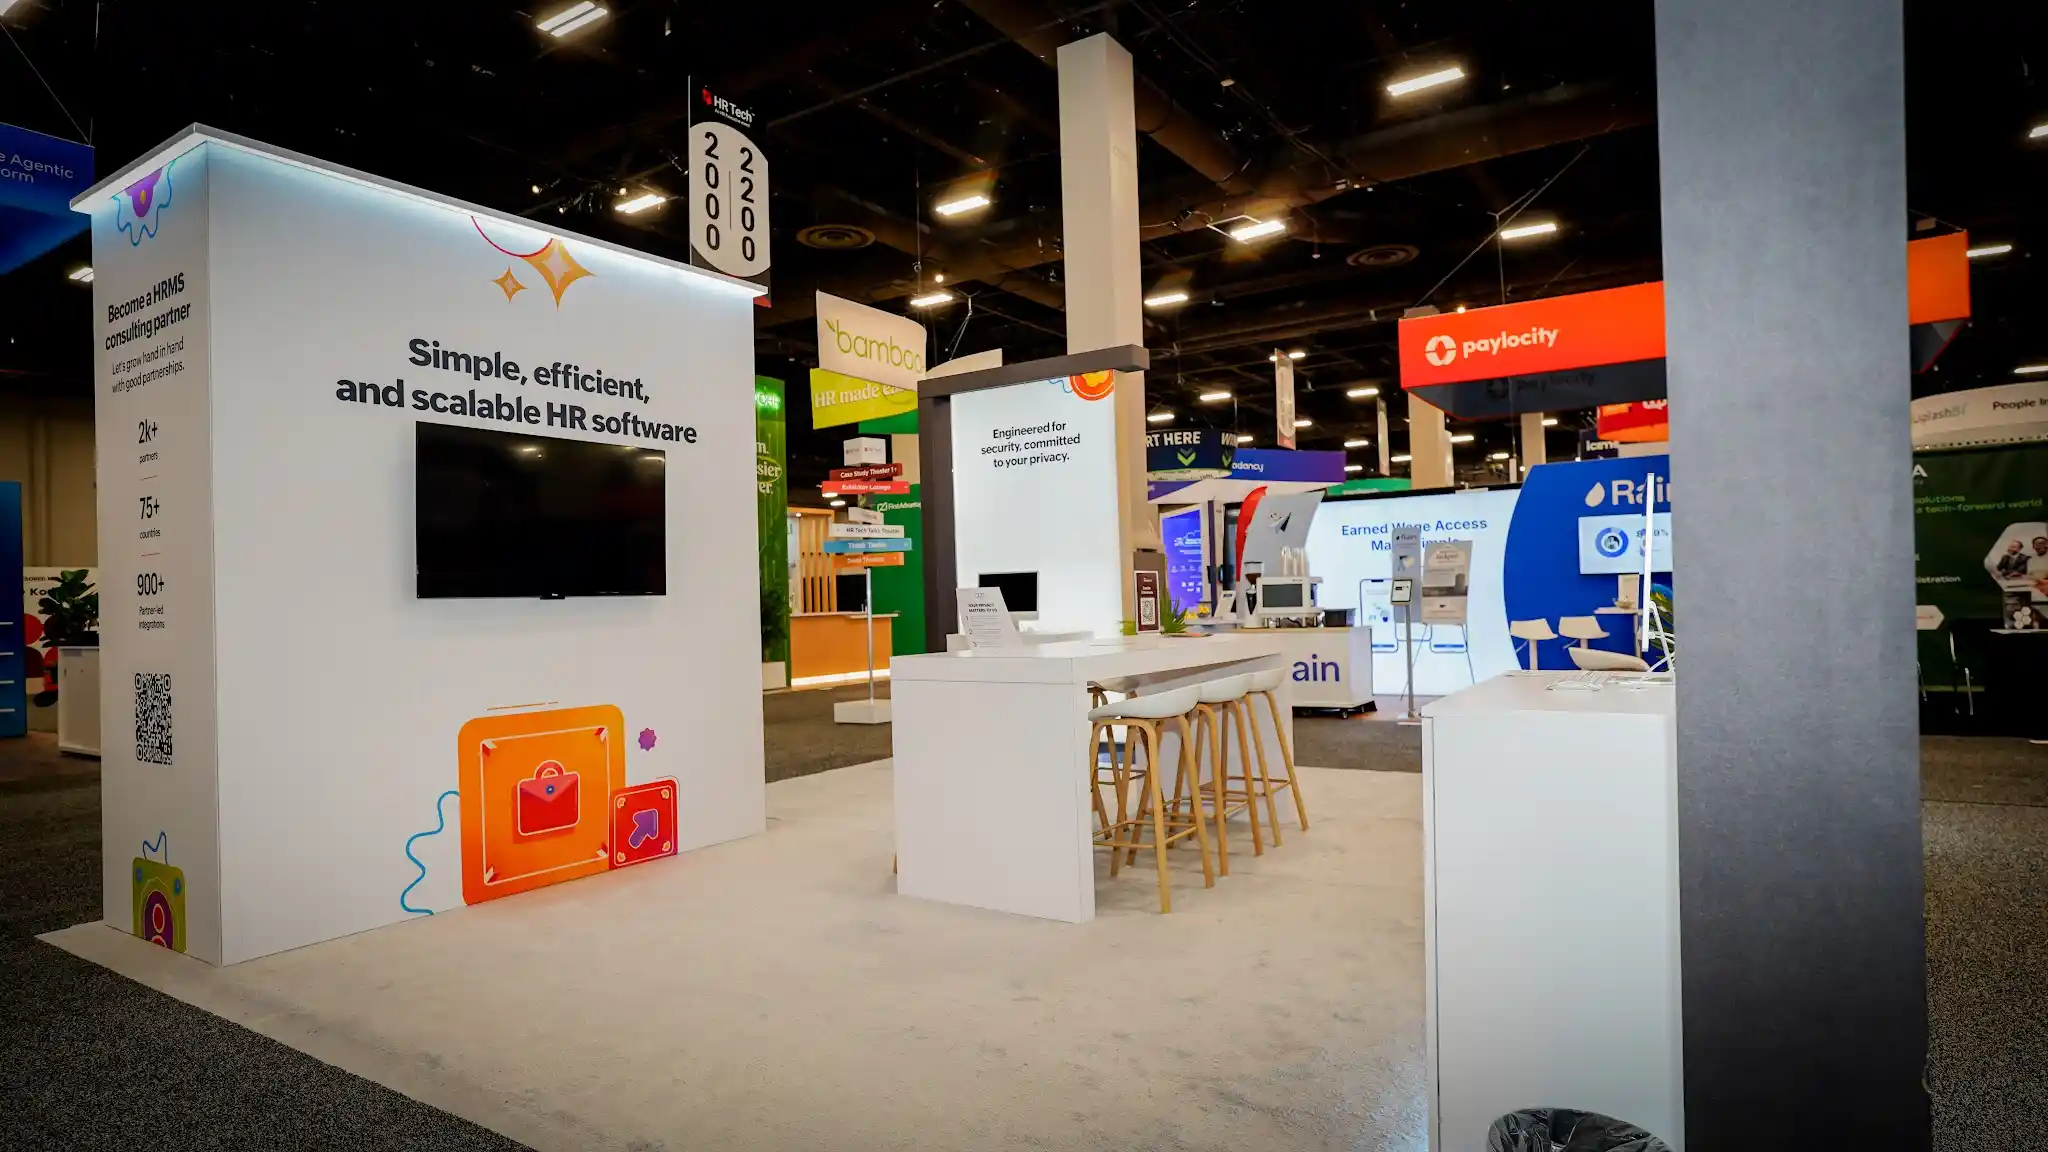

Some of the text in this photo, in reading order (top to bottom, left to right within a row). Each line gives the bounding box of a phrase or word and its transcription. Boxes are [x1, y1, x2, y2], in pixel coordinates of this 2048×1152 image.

[714, 95, 728, 112] HR
[729, 102, 752, 123] Tech
[10, 154, 74, 179] Agentic
[108, 272, 185, 323] Become a HRMS
[105, 302, 191, 350] consulting partner
[1463, 327, 1560, 358] paylocity
[112, 336, 184, 375] Let's grow hand in hand
[112, 359, 185, 393] with good partnerships.
[408, 338, 651, 404] Simple, efficient,
[814, 392, 836, 408] HR
[840, 384, 879, 403] made
[1992, 400, 2037, 411] People
[335, 379, 698, 444] and scalable HR software
[138, 419, 158, 443] 2k+
[993, 421, 1067, 439] Engineered for
[1163, 431, 1201, 446] HERE
[981, 433, 1081, 455] security, committed
[139, 451, 159, 464] partners
[993, 452, 1070, 468] to your privacy.
[1232, 461, 1264, 473] adancy
[854, 469, 869, 477] Study
[1611, 476, 1671, 505] Rai
[139, 496, 160, 519] 75+
[2008, 498, 2043, 509] world
[139, 528, 161, 539] countries
[1341, 524, 1389, 536] Earned
[1435, 519, 1488, 532] Access
[1371, 540, 1391, 551] Ma
[137, 573, 165, 596] 900+
[139, 605, 164, 616] Partner-led
[138, 618, 165, 630] integrations
[1292, 654, 1340, 682] ain
